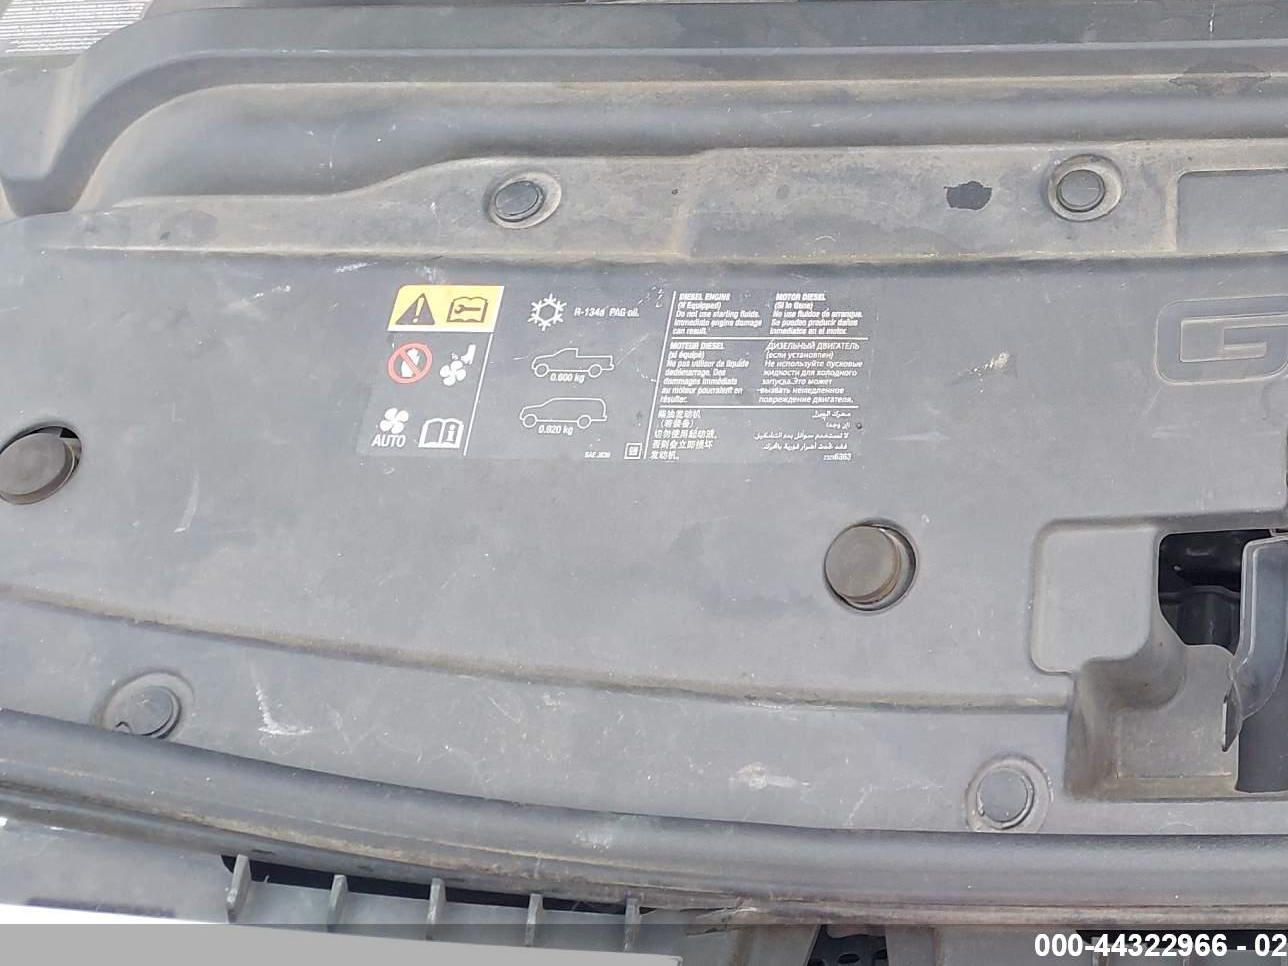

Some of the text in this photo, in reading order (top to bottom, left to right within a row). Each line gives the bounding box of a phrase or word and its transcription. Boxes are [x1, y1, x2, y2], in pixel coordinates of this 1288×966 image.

[679, 293, 730, 301] DIESEL ENGINE
[776, 293, 826, 301] MOTOR DIESEL
[609, 306, 626, 317] PAG
[670, 342, 724, 350] MOTEUR DIESEL
[574, 374, 585, 384] kg
[563, 426, 573, 436] kg
[371, 434, 406, 448] AUTO
